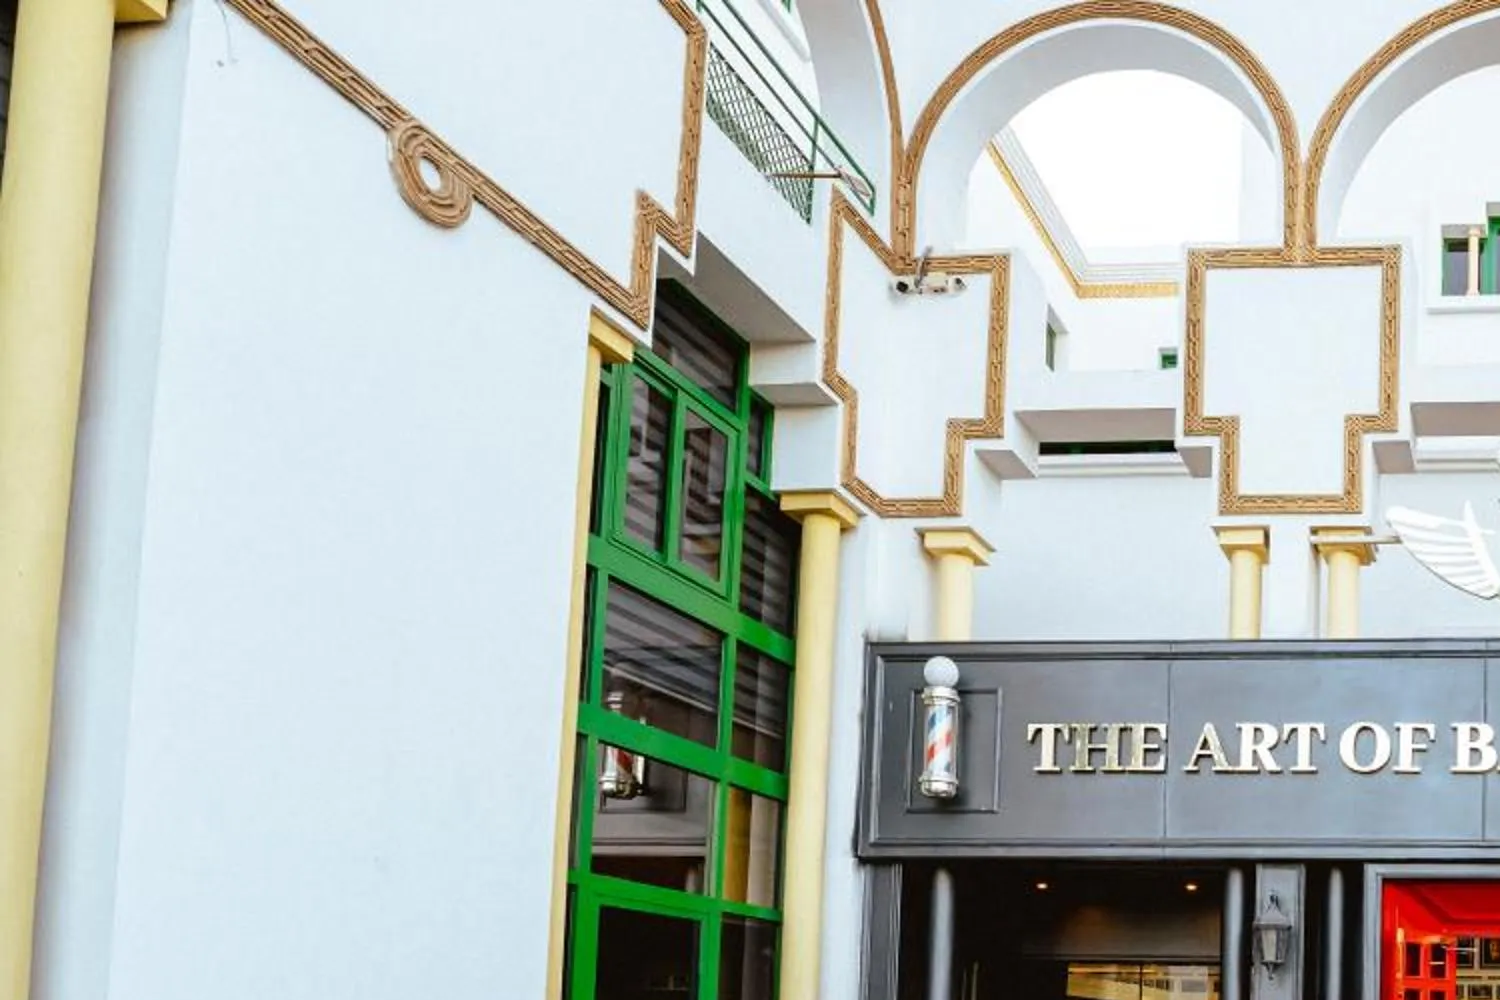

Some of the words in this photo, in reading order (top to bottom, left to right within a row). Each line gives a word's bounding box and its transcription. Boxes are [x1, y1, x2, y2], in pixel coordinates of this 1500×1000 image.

[1027, 722, 1168, 773] THE
[1183, 722, 1327, 773] ART
[1339, 721, 1436, 774] OF
